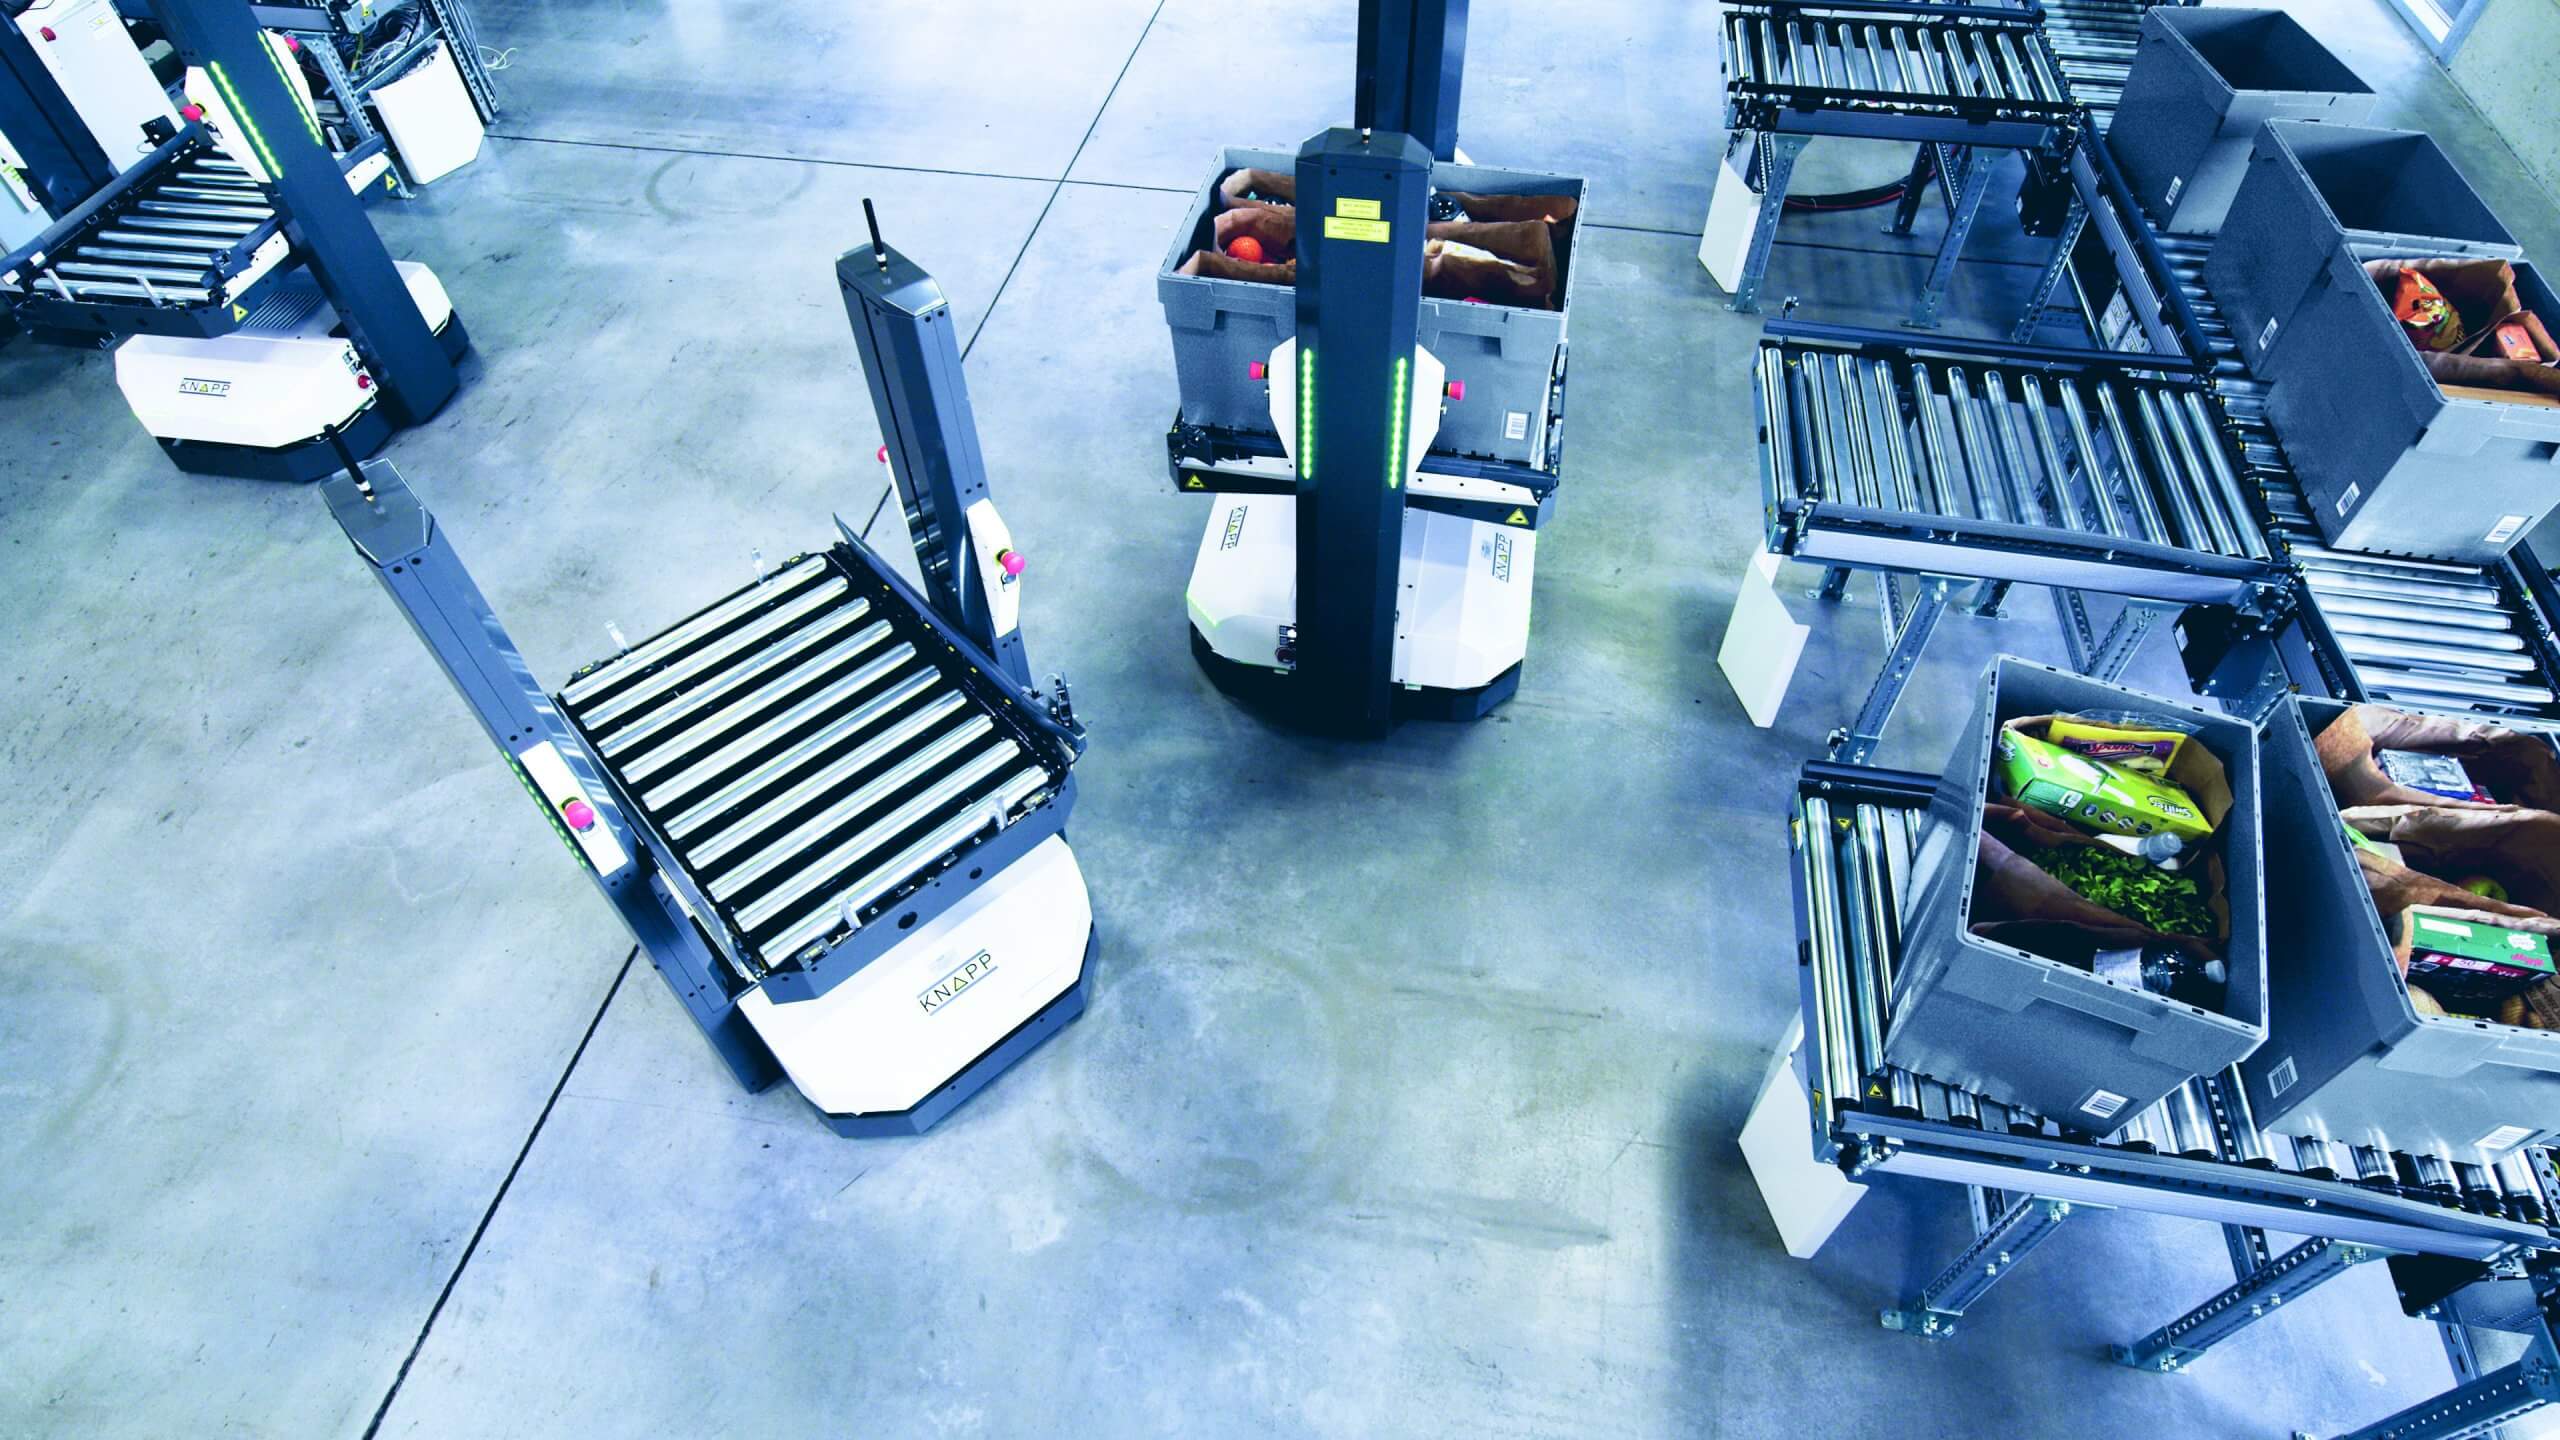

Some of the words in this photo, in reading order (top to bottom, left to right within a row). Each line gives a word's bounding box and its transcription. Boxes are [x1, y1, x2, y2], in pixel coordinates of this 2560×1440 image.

[179, 380, 231, 393] KNAPP
[1495, 533, 1509, 581] KNAPP
[919, 953, 991, 1012] KNAPP
